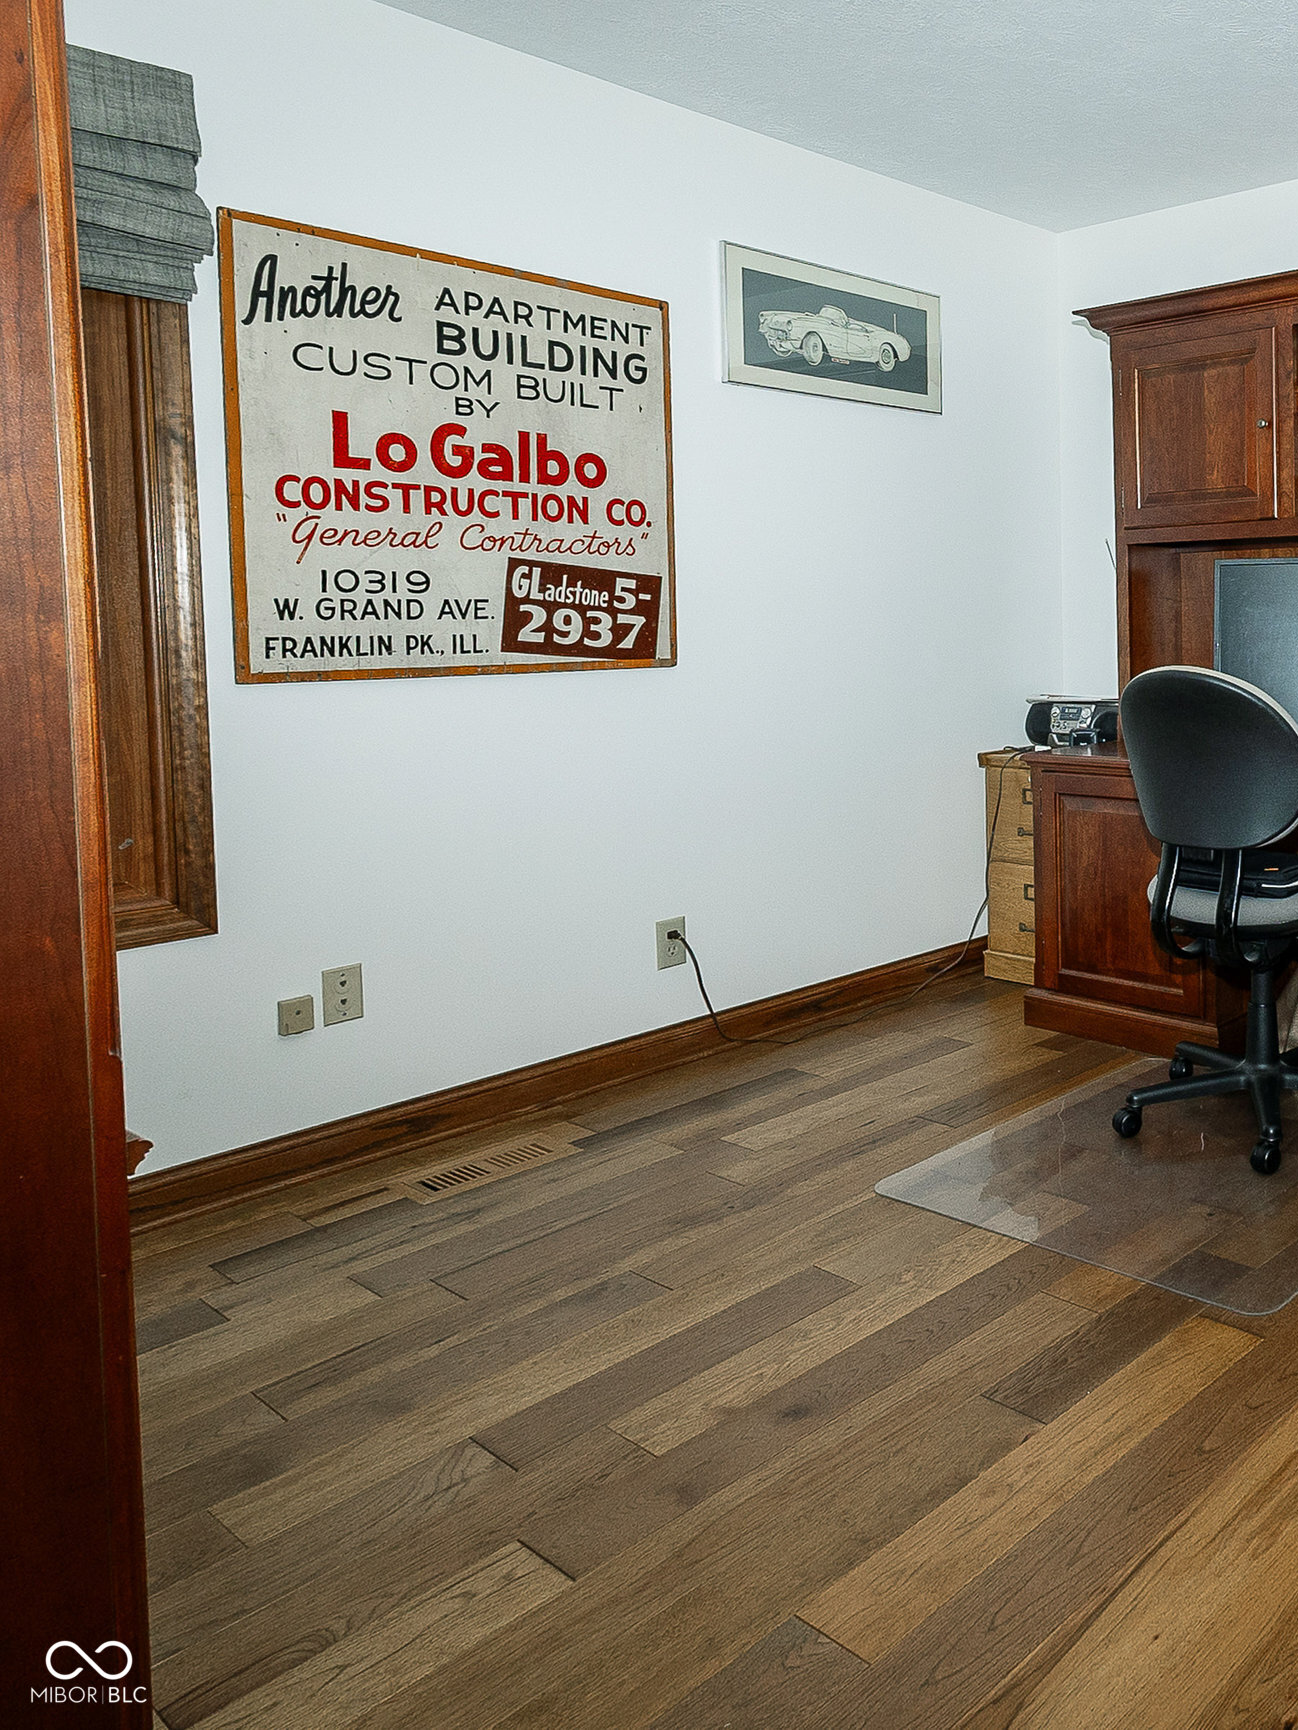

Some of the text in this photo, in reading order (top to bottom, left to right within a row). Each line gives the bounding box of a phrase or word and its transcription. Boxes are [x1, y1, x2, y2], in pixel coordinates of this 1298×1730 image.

[241, 254, 652, 347] Another APARTMENT
[435, 320, 649, 385] BUILDING
[291, 342, 624, 412] CUSTOM BUILT
[454, 396, 500, 418] BY
[331, 409, 608, 489] Lo Galbo
[274, 474, 653, 528] CONSTRUCTION CO.
[319, 568, 431, 594] 10319
[510, 565, 652, 609] GLadstone 5-
[273, 597, 495, 621] W. GRAND AVE.
[516, 603, 647, 649] 2937
[264, 634, 490, 659] FRANKLIN PK., ILL.
